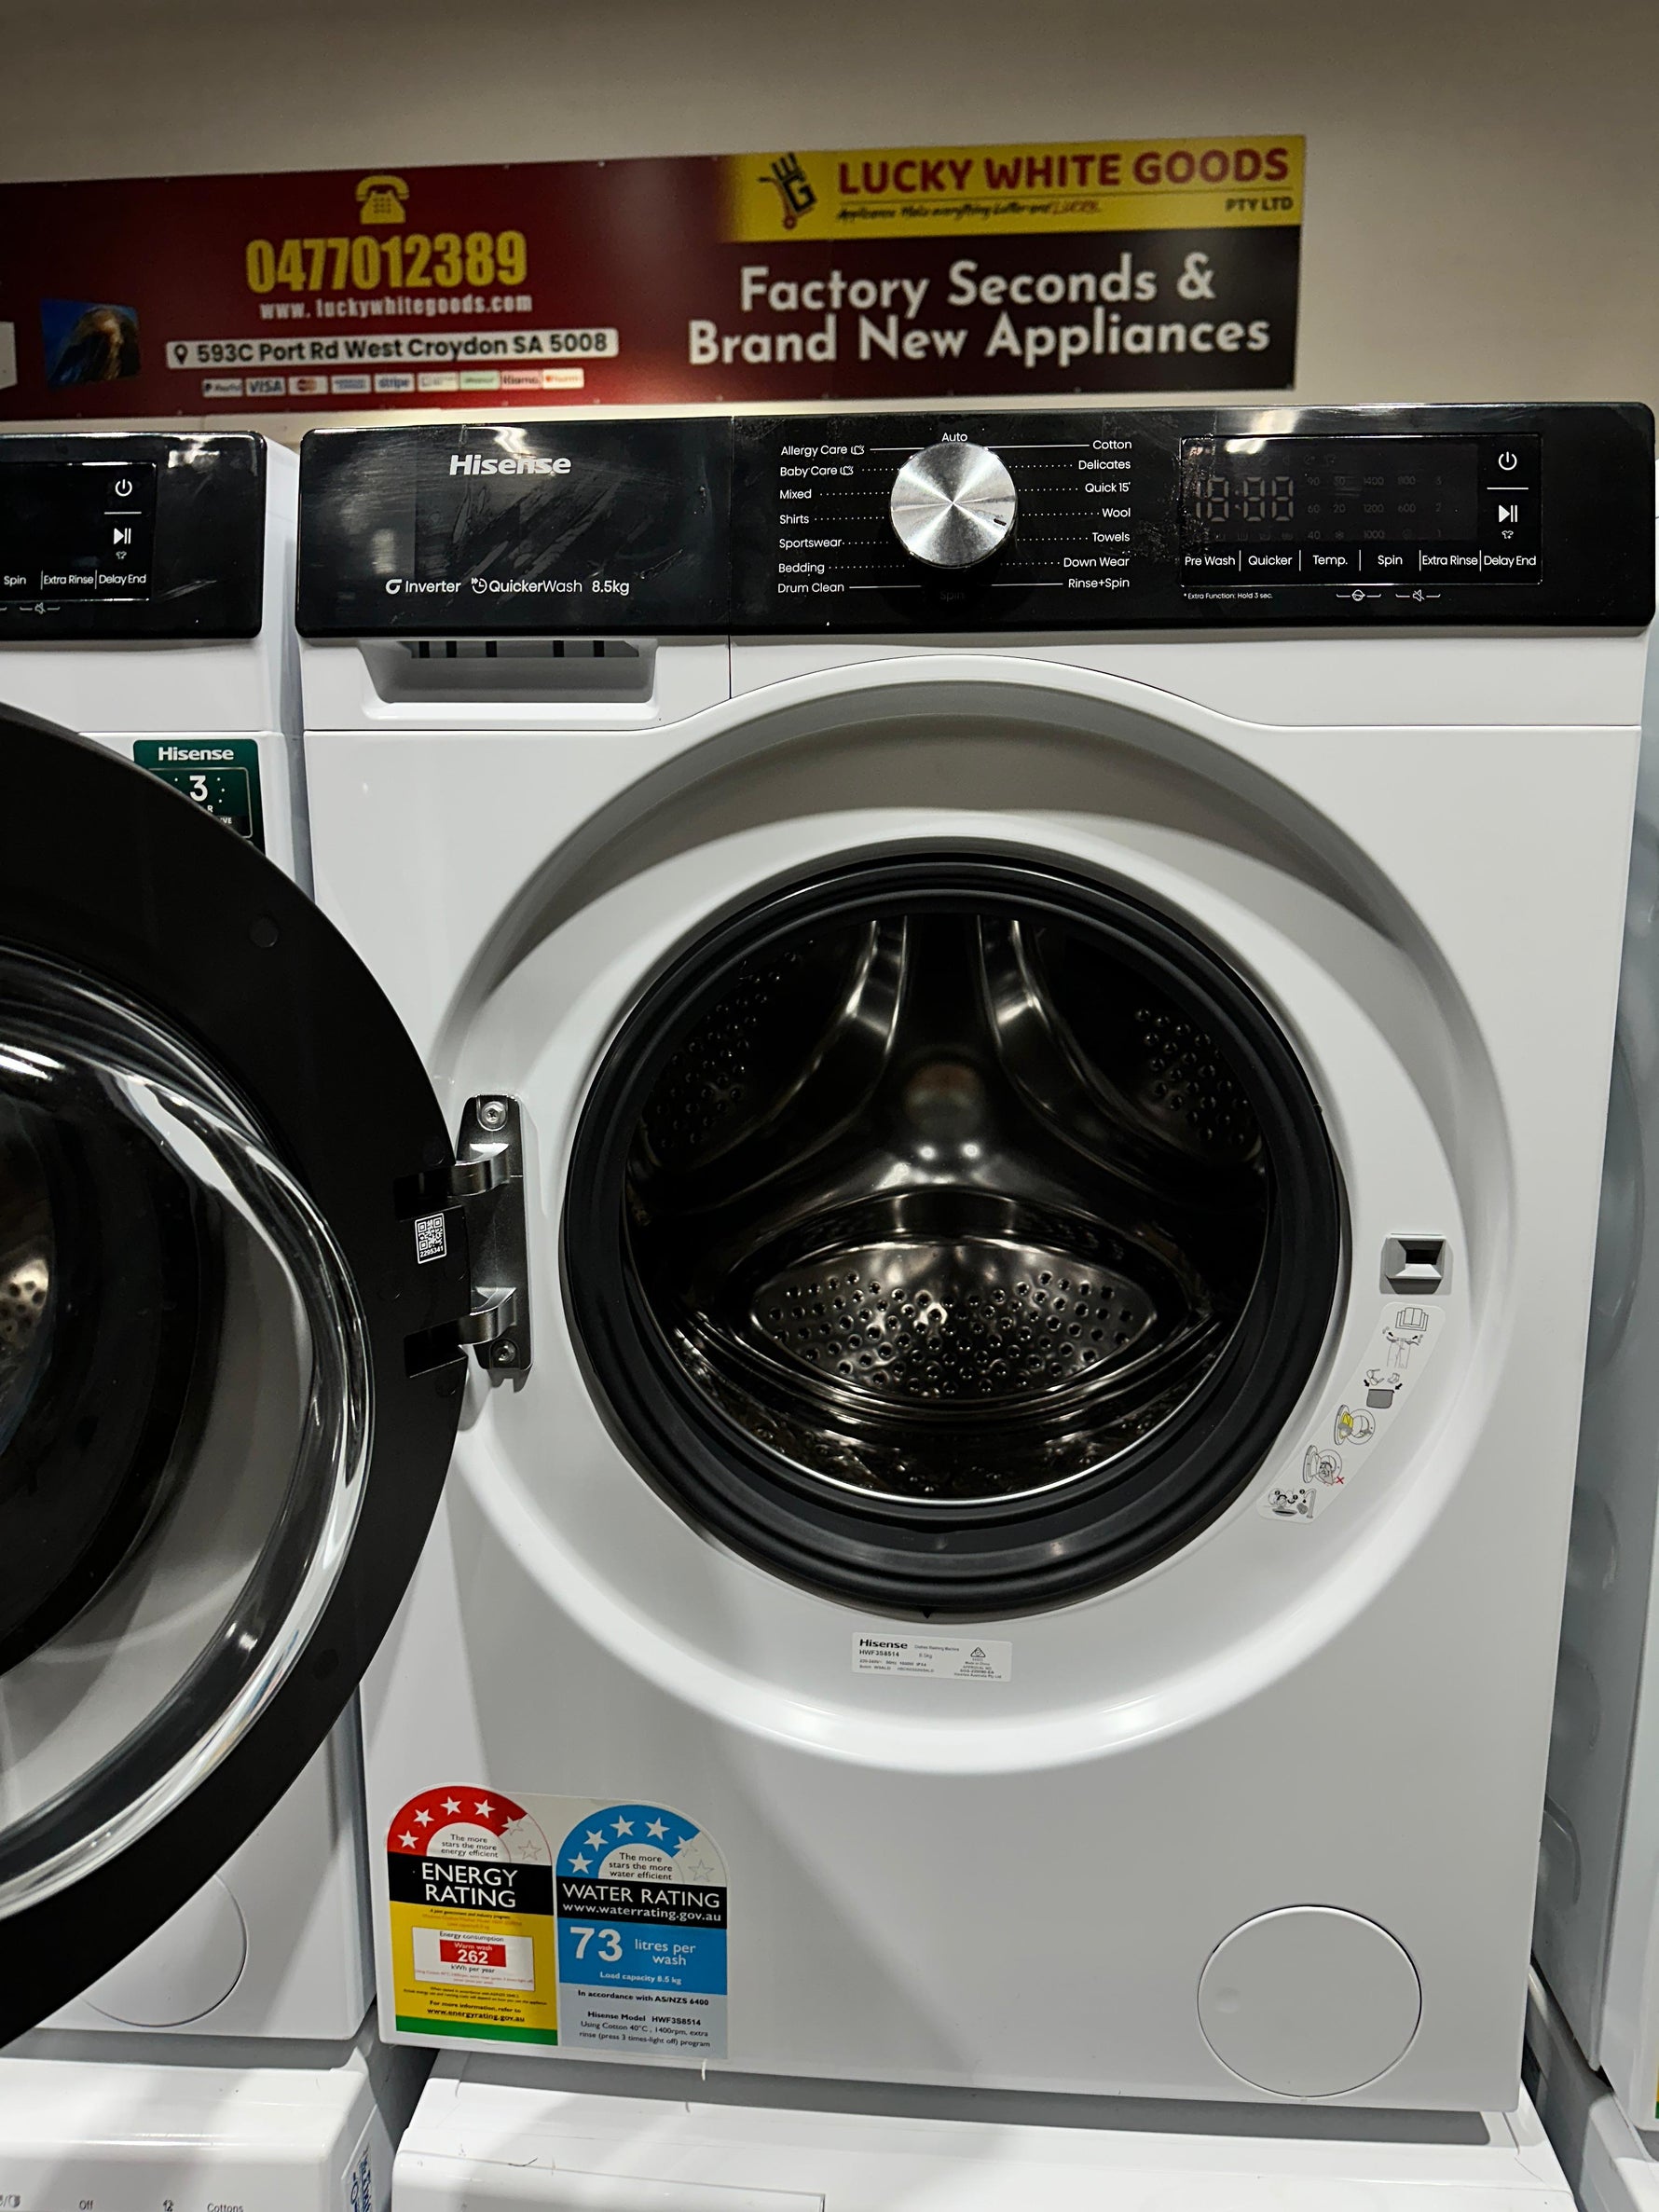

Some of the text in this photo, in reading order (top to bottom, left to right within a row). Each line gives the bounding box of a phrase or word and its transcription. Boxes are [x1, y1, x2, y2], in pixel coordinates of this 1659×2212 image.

[839, 147, 1290, 195] LUCKY WHITE GOODS
[1225, 196, 1294, 213] PTY LTD
[246, 230, 528, 294] 0477012389
[740, 252, 1215, 319] Factory Seconds &
[316, 294, 533, 319] luckywhitegoods.com
[689, 308, 1270, 368] Brand New Appliances
[197, 332, 608, 364] 593C Port Rd West Croydon SA 5008
[249, 379, 283, 393] VISA
[941, 432, 968, 443] Auto
[1092, 439, 1132, 450] Cotton
[780, 445, 848, 459] Allergy Care
[449, 454, 571, 476] Hisense
[780, 465, 838, 478] Baby Care
[1078, 460, 1131, 471] Delicates
[779, 488, 812, 500] Mixed
[1084, 482, 1117, 493] Quick
[779, 514, 810, 525] Shirts
[1102, 508, 1131, 518] Wool
[1091, 531, 1131, 543] Towels
[779, 537, 842, 551] Sportswear
[1063, 556, 1130, 569] Down Wear
[1185, 556, 1236, 566] Pre Wash
[1248, 556, 1293, 567] Quicker
[1312, 555, 1349, 568] Temp.
[1378, 555, 1403, 568] Spin
[1422, 555, 1478, 566] Extra Rinse
[1484, 556, 1537, 569] Delay End
[778, 562, 825, 575] Bedding
[4, 575, 27, 586] Spin
[44, 574, 94, 585] Extra Rinse
[99, 574, 146, 586] Delay End
[1068, 578, 1130, 591] Rinse+Spin
[405, 580, 630, 596] Inverter QuickerWash 8.5kg
[777, 582, 844, 594] Drum Clean
[158, 747, 234, 762] Hisense
[189, 775, 208, 802] 3
[859, 1639, 908, 1650] Hisense
[450, 1834, 465, 1842] The
[440, 1848, 500, 1859] energy efficient
[619, 1852, 663, 1863] The more
[632, 1862, 648, 1871] the
[649, 1864, 673, 1873] more
[421, 1862, 518, 1888] ENERGY
[637, 1872, 673, 1881] efficient
[425, 1883, 516, 1908] RATING
[562, 1883, 720, 1909] WATER RATING
[562, 1903, 721, 1923] www.waterrating.gov.au
[439, 1930, 504, 1944] Energy consumption
[569, 1926, 623, 1962] 73
[635, 1939, 696, 1956] litres per
[457, 1949, 488, 1964] 262
[651, 1954, 687, 1966] wash
[599, 1971, 620, 1980] Load
[622, 1973, 655, 1984] capacity
[671, 1976, 682, 1985] kg
[587, 1990, 634, 2000] accordance
[635, 1992, 652, 2001] with
[654, 1995, 688, 2005] AS/NZS
[689, 1998, 709, 2006] 6400
[427, 2008, 526, 2024] www.energyrating.gov.au
[587, 2011, 619, 2021] Hisense
[621, 2013, 646, 2022] Model
[581, 2020, 600, 2030] Using
[601, 2022, 628, 2031] Cotton
[579, 2030, 596, 2039] rinse
[597, 2032, 620, 2041] (press
[627, 2035, 665, 2044] times-light
[665, 2037, 679, 2046] off)
[679, 2040, 711, 2048] program
[79, 2200, 94, 2211] Off
[207, 2203, 244, 2212] Cottons
